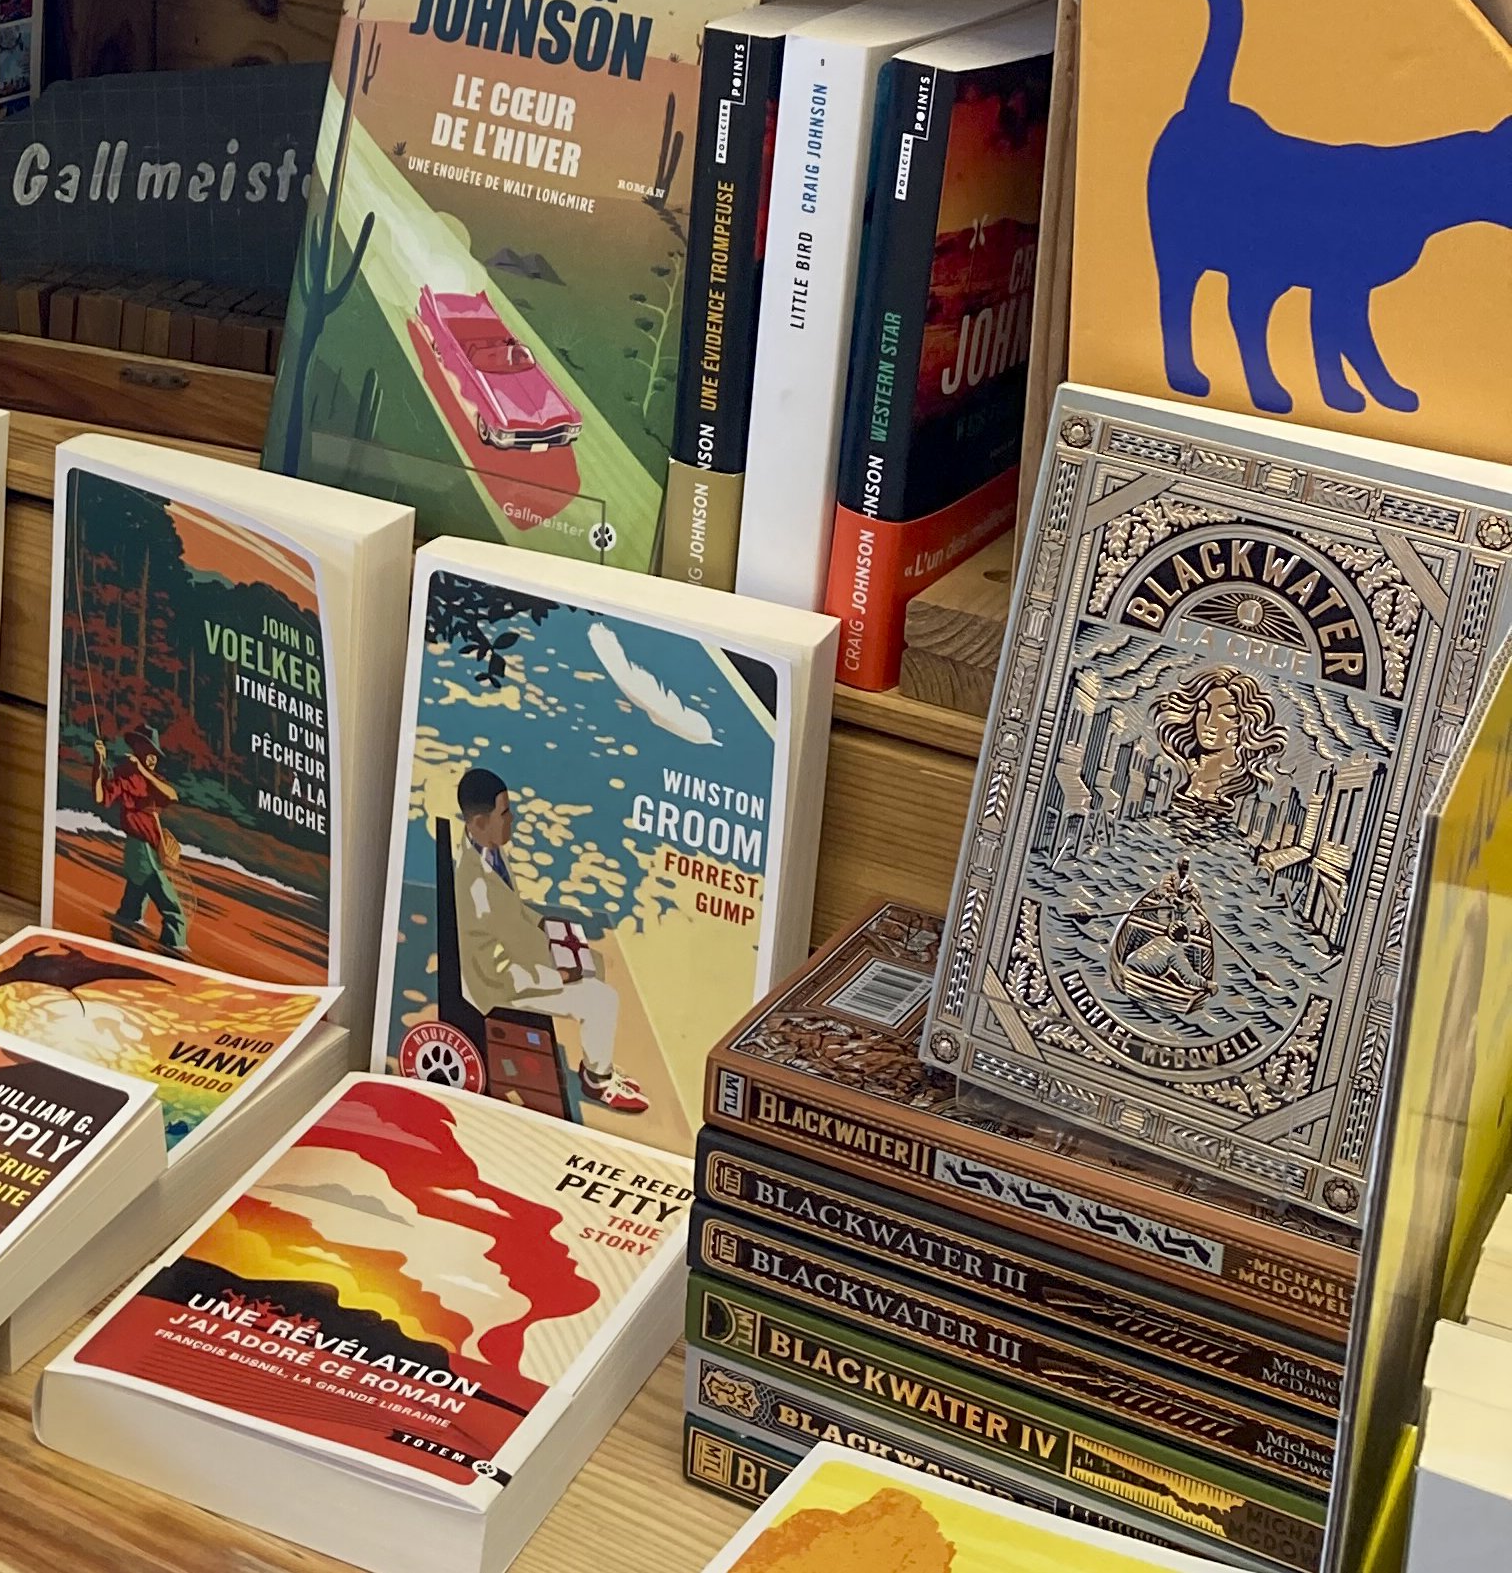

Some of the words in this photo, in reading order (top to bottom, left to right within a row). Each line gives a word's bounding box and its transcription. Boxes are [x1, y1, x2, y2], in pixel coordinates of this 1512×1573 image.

[452, 74, 485, 108] LE
[731, 42, 745, 96] POINTS
[806, 83, 828, 156] JOHNSON
[915, 75, 931, 131] POINTS
[431, 111, 473, 146] DE
[475, 118, 582, 178] L'HIVER
[717, 102, 729, 160] POLICIER
[408, 156, 428, 171] UNE
[432, 157, 480, 188] ENQUÊTE
[485, 173, 499, 190] DE
[502, 178, 533, 201] WALT
[535, 185, 596, 213] LONGMIRE
[618, 178, 665, 199] ROMAN
[802, 159, 821, 214] CRAIG
[897, 136, 913, 196] POLICIER
[796, 230, 813, 273] BIRD
[790, 279, 809, 330] LITTLE
[503, 501, 585, 540] Gallmeister
[852, 529, 875, 614] JOHNSON
[1125, 538, 1366, 680] BLACKWATER
[204, 619, 322, 700] VOELKER
[262, 613, 301, 653] JOHN
[304, 631, 321, 661] D.
[845, 619, 864, 671] CRAIG
[234, 675, 324, 727] ITINÉRAIRE
[251, 733, 326, 782] PÊCHEUR
[288, 721, 325, 755] D'UN
[258, 789, 326, 834] MOUCHE
[291, 770, 304, 798] À
[308, 783, 326, 809] LA
[663, 768, 764, 821] WINSTON
[632, 794, 763, 867] GROOM
[664, 852, 759, 899] FORREST
[696, 892, 755, 926] GUMP
[168, 1039, 257, 1079] VANN
[214, 1031, 275, 1056] DAVID
[148, 1062, 234, 1095] KOMODO
[555, 1172, 683, 1224] PETTY
[565, 1151, 627, 1179] KATE
[633, 1171, 692, 1200] REED
[578, 1224, 654, 1259] STORY
[605, 1215, 661, 1242] TRUE
[753, 1179, 983, 1282] BLACKWATER
[991, 1255, 1028, 1293] III
[750, 1250, 978, 1352] BLACKWATER
[986, 1328, 1022, 1364] III
[169, 1308, 218, 1336] J'AI
[222, 1322, 316, 1370] ADORÉ
[316, 1357, 358, 1381] CE
[358, 1368, 466, 1415] ROMAN
[186, 1291, 258, 1329] UNE
[265, 1315, 482, 1398] RÉVÉLATION
[155, 1328, 228, 1356] FRANÇOIS
[229, 1349, 291, 1380] BUSNEL,
[292, 1371, 312, 1387] LA
[312, 1375, 377, 1406] GRANDE
[377, 1399, 452, 1429] LIBRAIRIE
[769, 1332, 1010, 1446] BLACKWATER
[1020, 1424, 1057, 1459] IV
[402, 1431, 467, 1464] TOTEM
